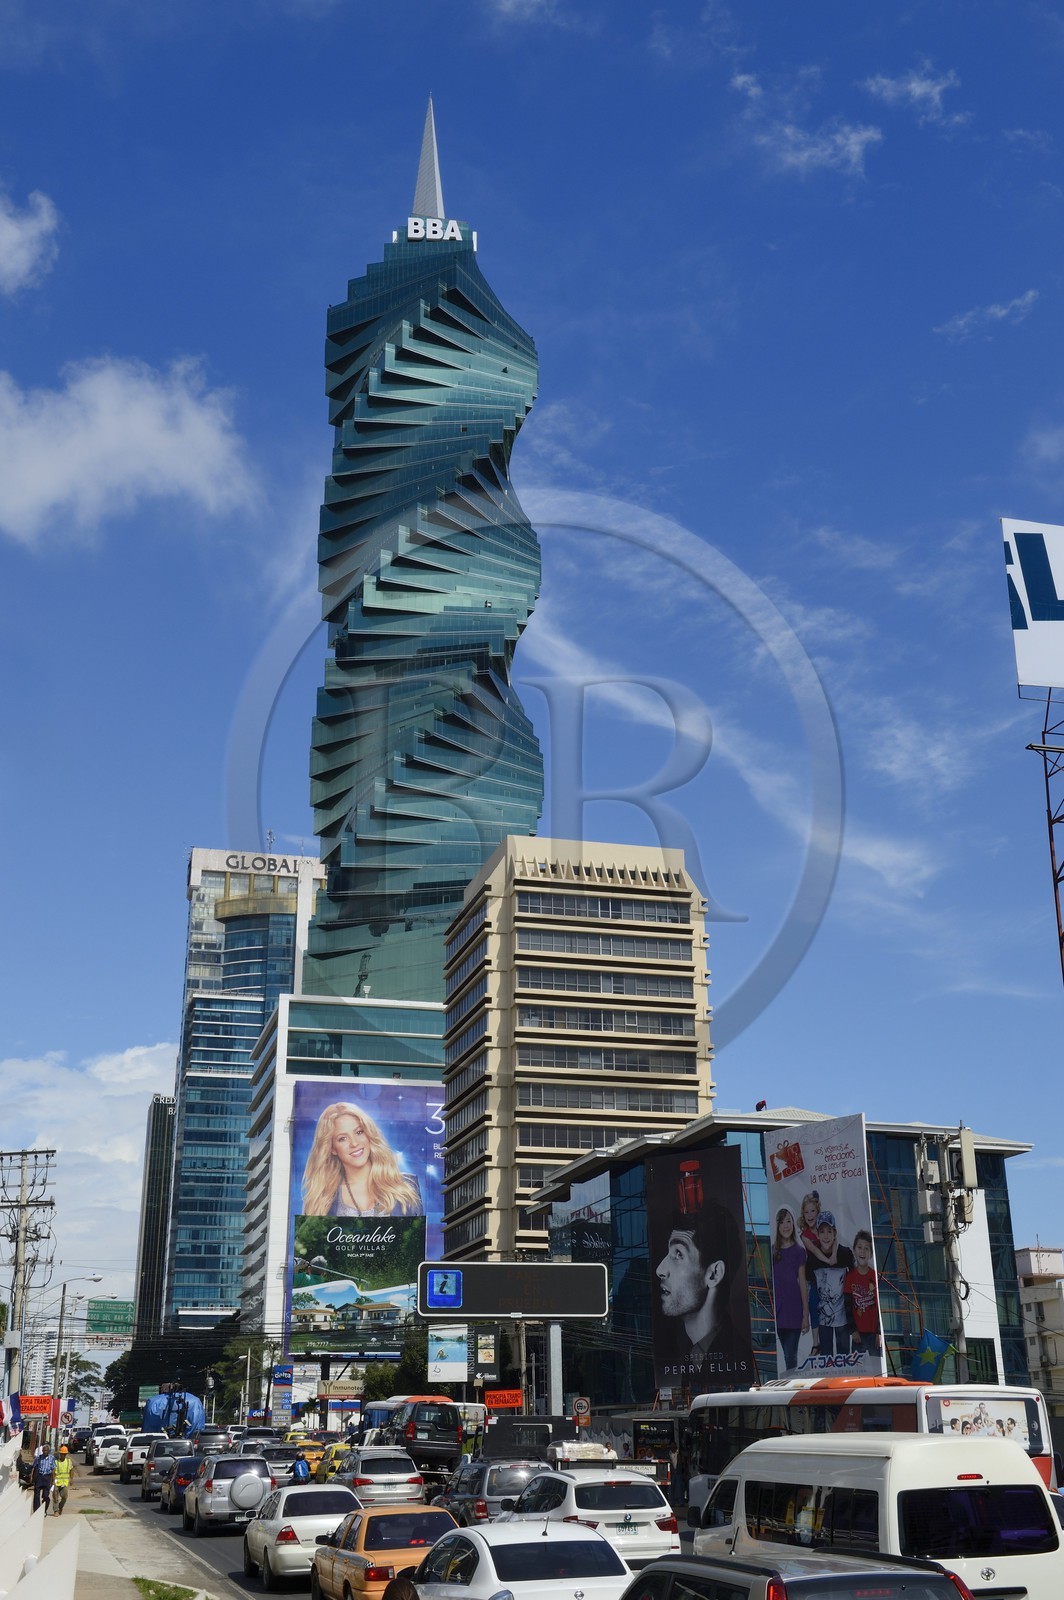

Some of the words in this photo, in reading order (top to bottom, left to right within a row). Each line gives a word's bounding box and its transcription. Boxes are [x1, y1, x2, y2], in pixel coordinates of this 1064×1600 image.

[407, 217, 463, 241] BBA
[226, 854, 299, 874] GLOBAL
[425, 1102, 446, 1135] 3
[326, 1226, 396, 1243] Oceanlake
[684, 1352, 724, 1362] SPIRITED
[664, 1364, 702, 1375] PERRY
[710, 1361, 747, 1373] ELLIS
